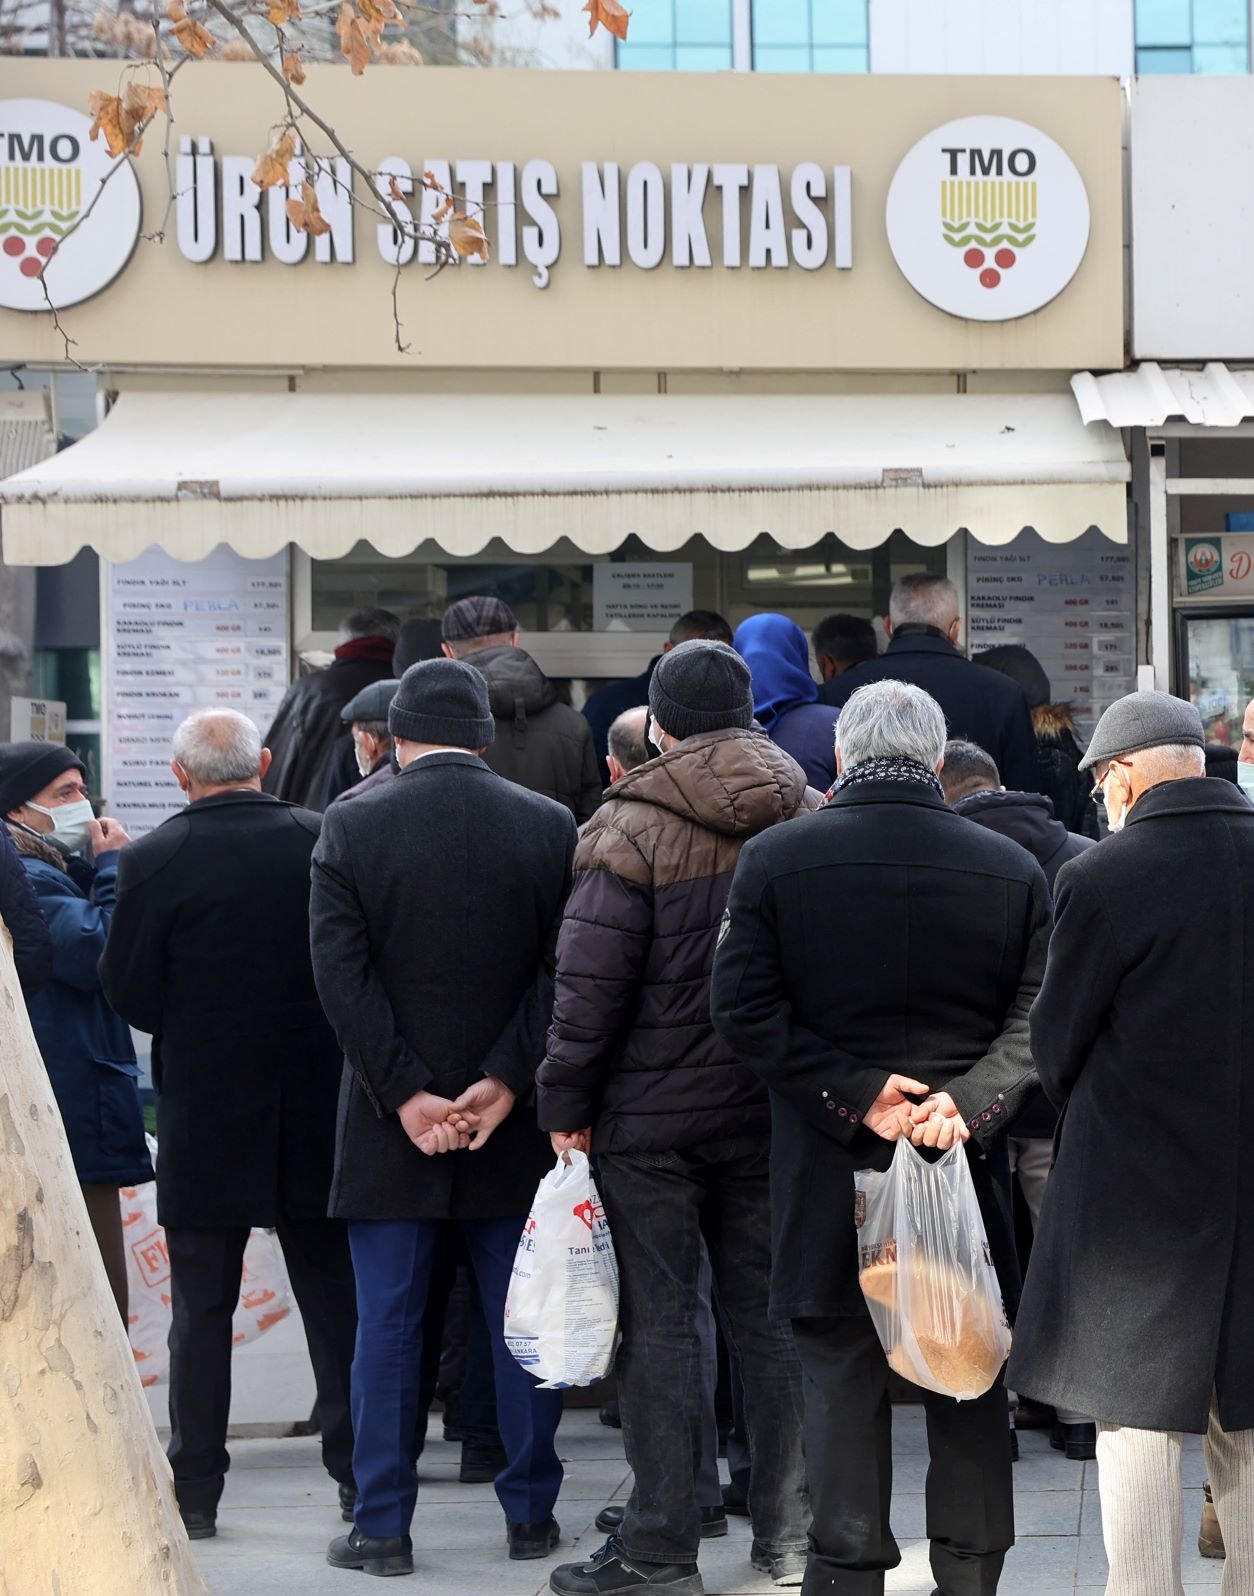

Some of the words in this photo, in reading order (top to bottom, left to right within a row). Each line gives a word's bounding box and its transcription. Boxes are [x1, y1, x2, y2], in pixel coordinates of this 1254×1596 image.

[0, 132, 81, 163] MO
[940, 147, 1038, 177] TMO
[175, 135, 355, 265] ÜRÜN
[376, 156, 563, 290] SATIŞ
[581, 159, 854, 271] NOKTASI
[1037, 573, 1091, 586] PERLA
[182, 598, 240, 612] PERLA
